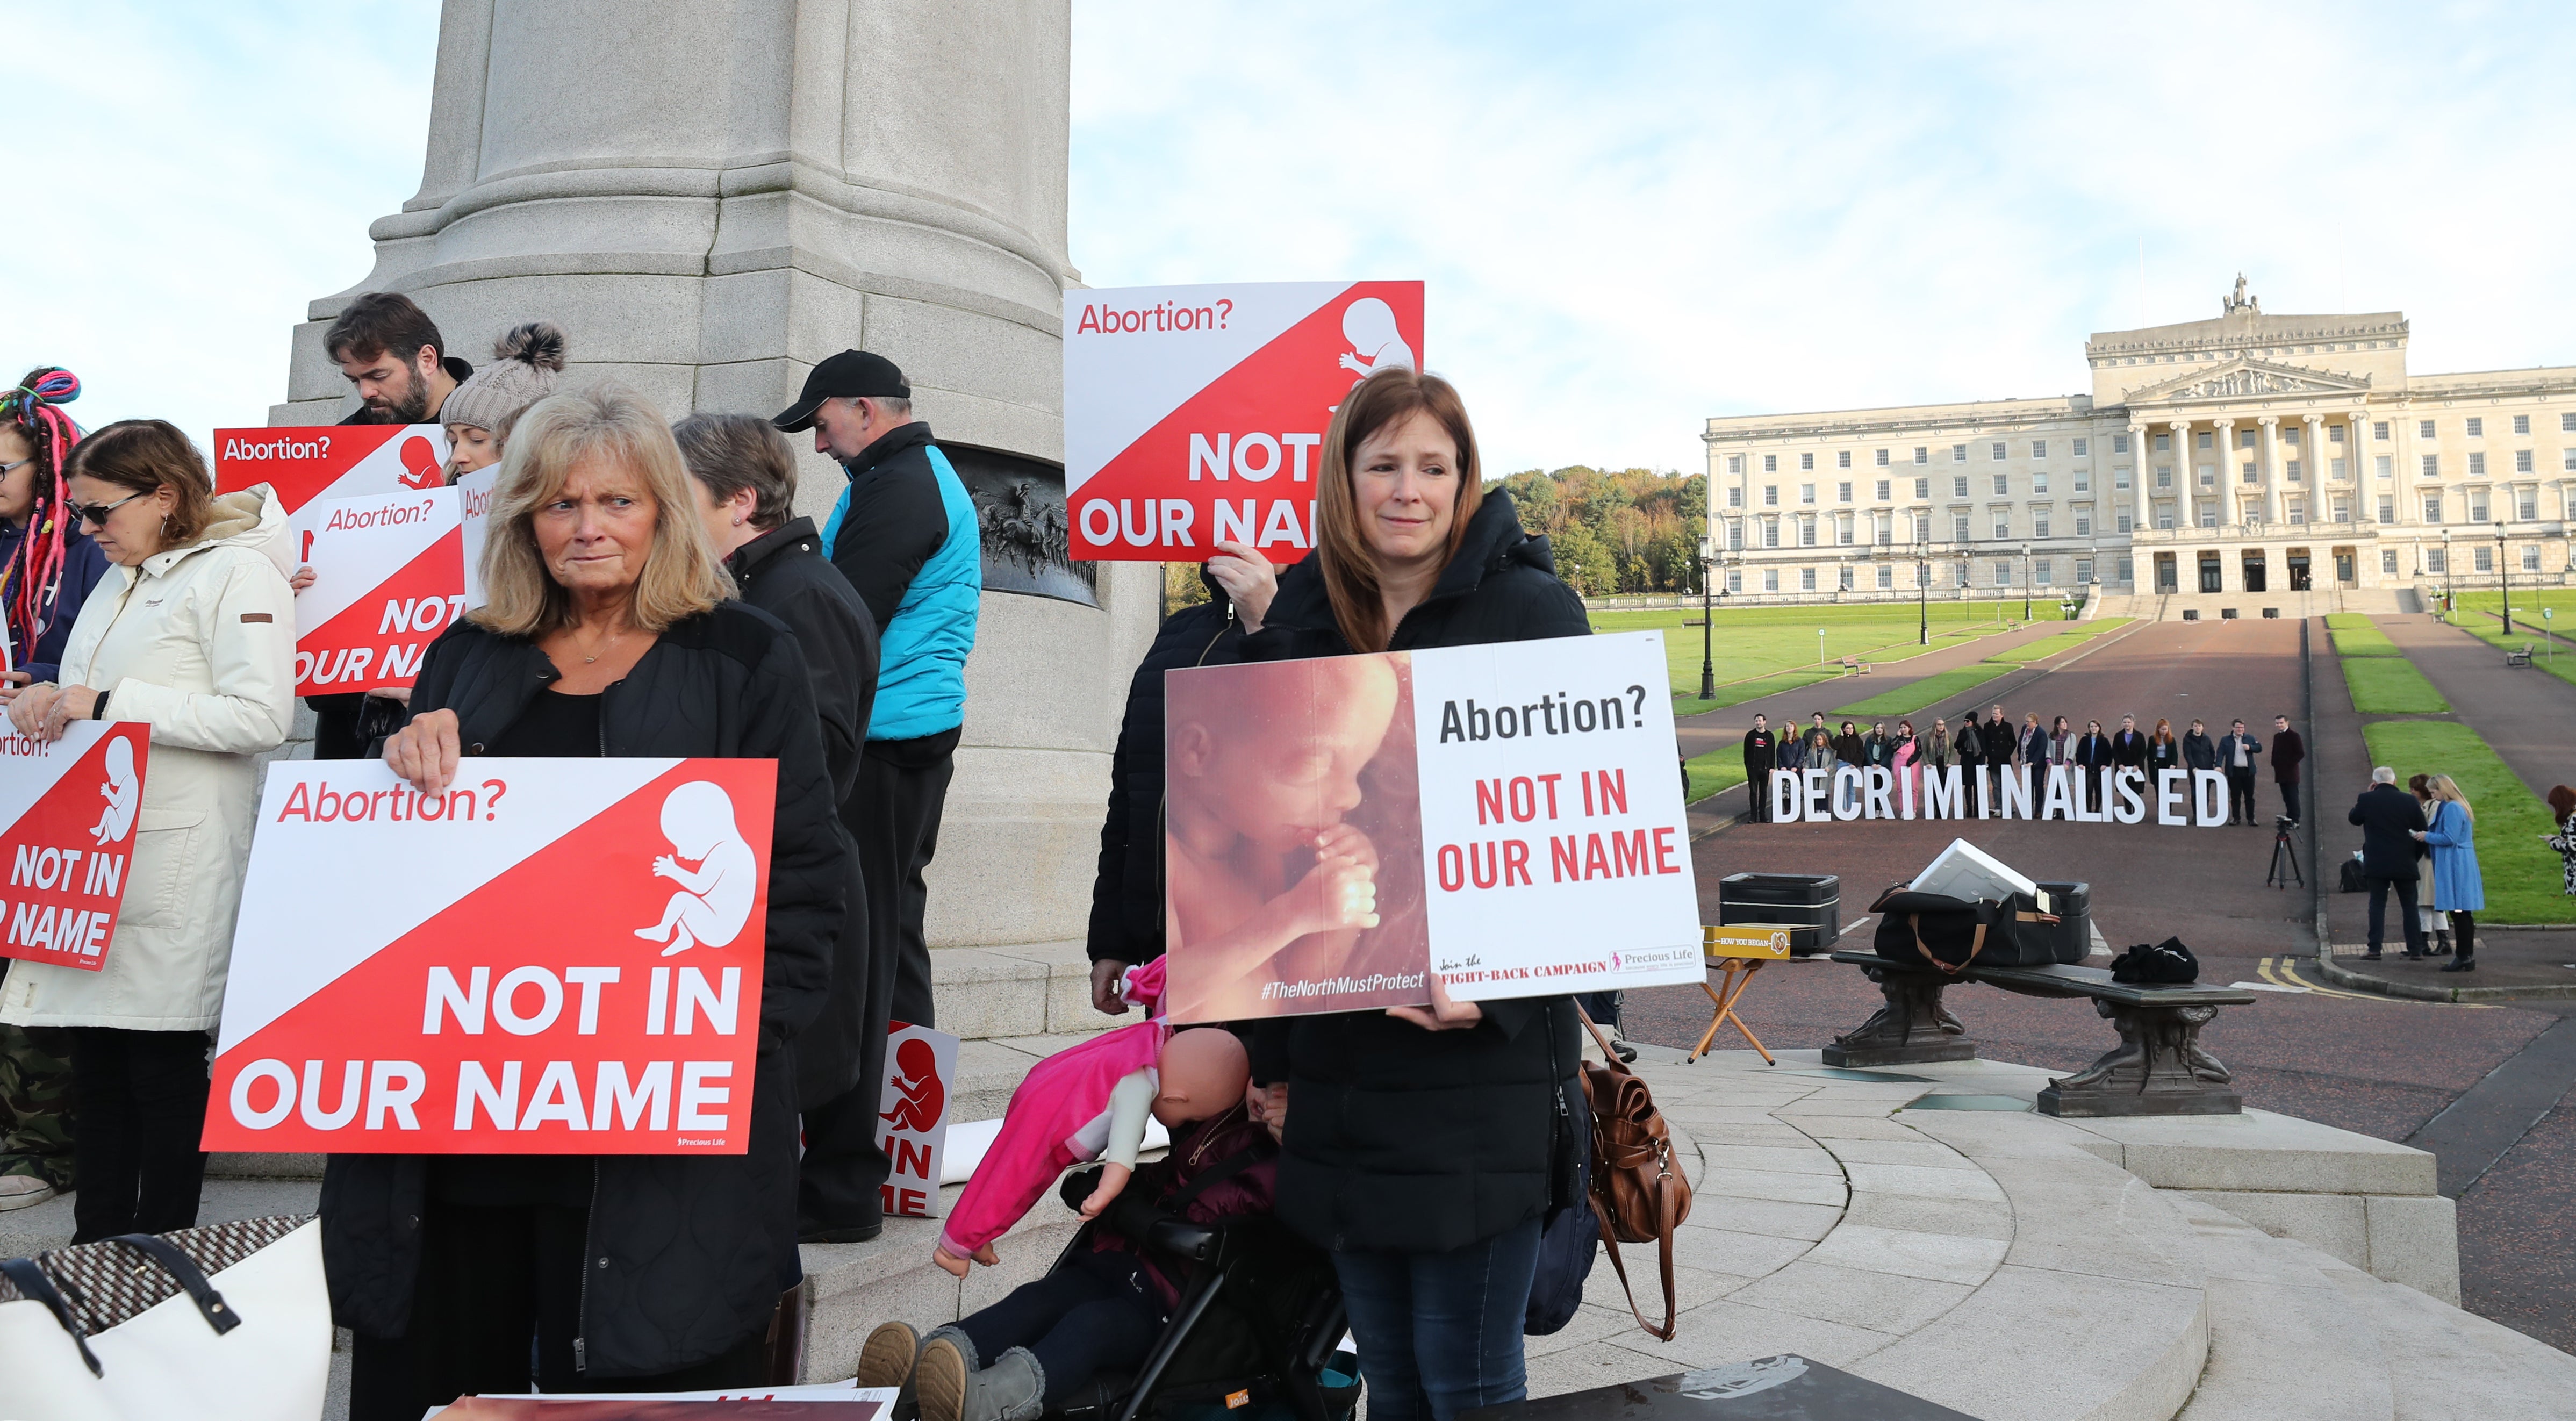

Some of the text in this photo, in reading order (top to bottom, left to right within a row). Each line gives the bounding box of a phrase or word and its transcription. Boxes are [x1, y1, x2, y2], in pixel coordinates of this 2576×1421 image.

[1077, 299, 1233, 334] Abortion?
[224, 436, 331, 460] Abortion?
[1188, 432, 1320, 482] NOT
[326, 499, 433, 532] Abortion?
[1079, 498, 1318, 548] OUR NA
[296, 647, 374, 686] OUR
[1440, 685, 1646, 744] Abortion?
[277, 779, 506, 822] Abortion?
[1475, 769, 1627, 825] NOT IN
[1773, 764, 2229, 827] DECRIMINALISED
[10, 844, 124, 898] NOT IN
[1437, 827, 1681, 892] OUR NAME
[8, 902, 110, 957] NAME
[1440, 954, 1481, 971] Join the
[1442, 961, 1606, 984] FIGHT-BACK CAMPAIGN
[1625, 950, 1693, 963] Precious Life
[422, 966, 741, 1035] NOT IN
[1261, 971, 1424, 1000] #TheNorthMustProtect
[229, 1058, 733, 1130] OUR NAME
[884, 1135, 932, 1180] IN
